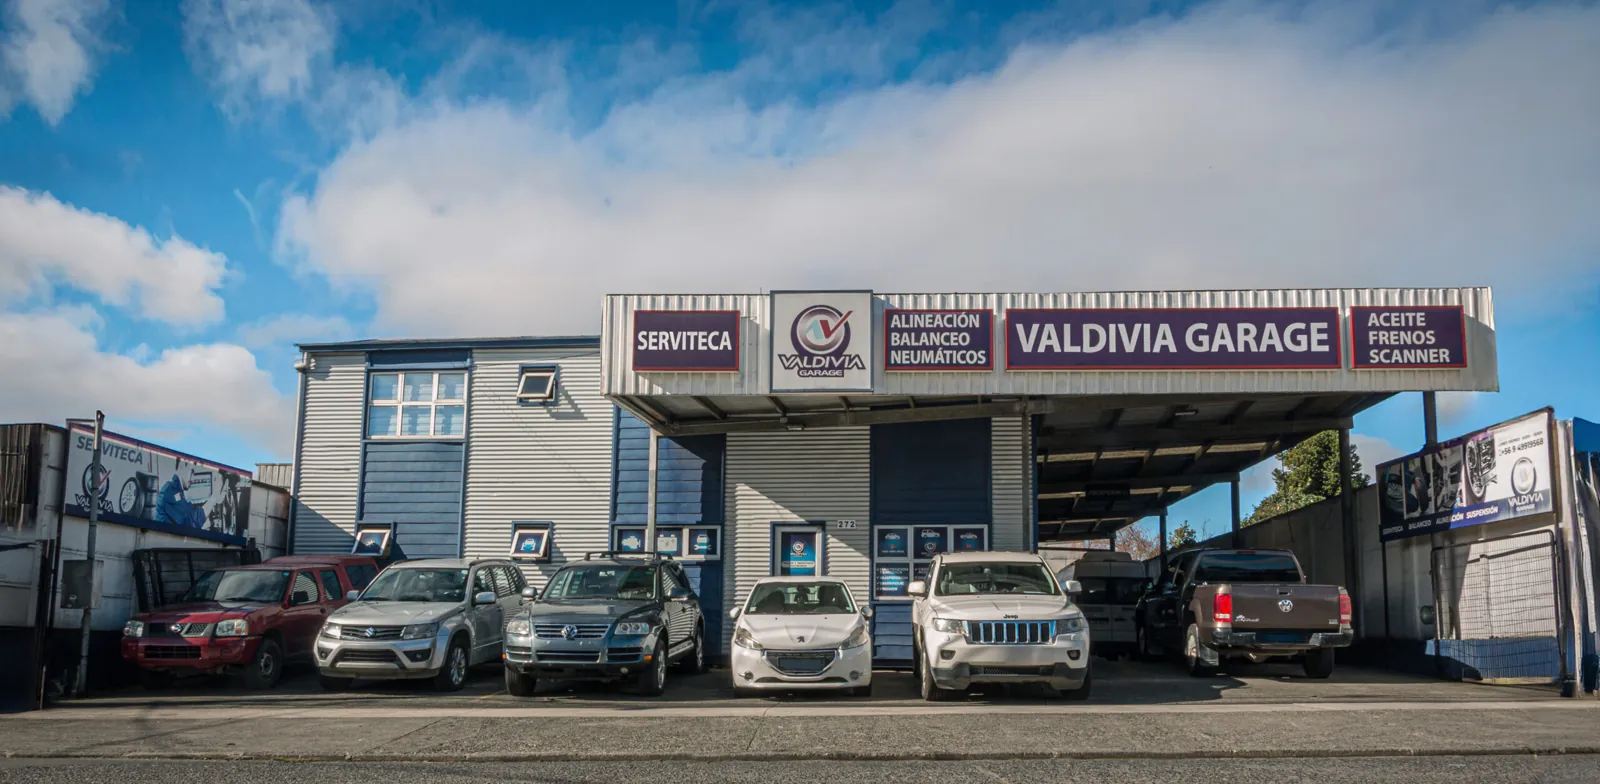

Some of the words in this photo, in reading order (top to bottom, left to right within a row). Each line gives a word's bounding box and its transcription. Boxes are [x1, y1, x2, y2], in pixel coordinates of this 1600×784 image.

[890, 312, 980, 329] ALINEACIÓN
[1367, 312, 1426, 327] ACEITE
[637, 330, 732, 351] SERVITECA
[890, 332, 970, 347] BALANCEO
[1015, 323, 1178, 354] VALDIVIA
[1185, 322, 1330, 353] GARAGE
[1368, 330, 1436, 346] FRENOS
[778, 355, 865, 369] VALDIVIA
[890, 348, 987, 365] NEUMÁTICOS
[1369, 347, 1450, 364] SCANNER
[799, 369, 843, 377] GARAGE
[76, 435, 143, 465] SEVITECA
[1512, 444, 1516, 452] 9
[74, 493, 114, 512] VALVIA
[1508, 492, 1544, 506] VALDIVIA
[1466, 504, 1499, 519] SUSPENSIÓN
[838, 520, 855, 528] 272
